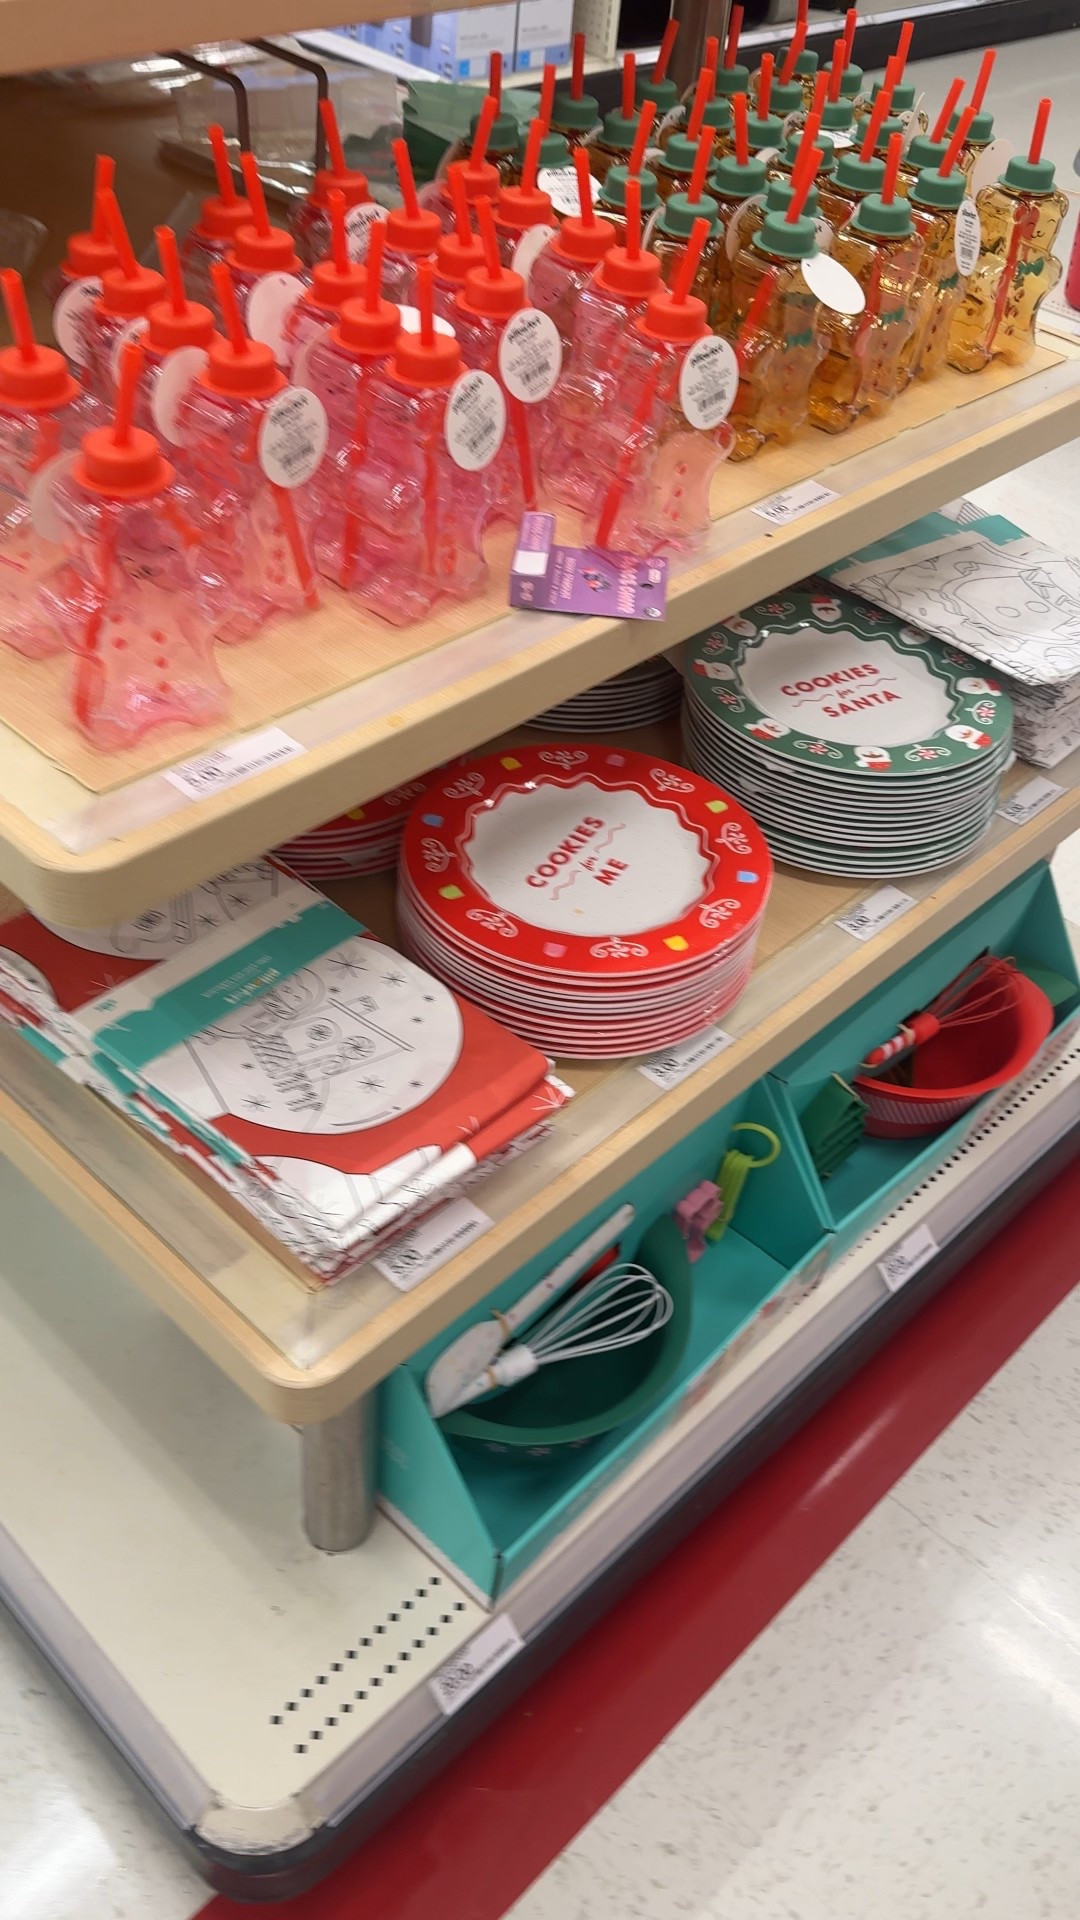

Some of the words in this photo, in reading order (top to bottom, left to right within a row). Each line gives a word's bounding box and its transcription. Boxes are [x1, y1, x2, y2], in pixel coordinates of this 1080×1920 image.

[781, 664, 880, 697] COOKIES
[836, 688, 855, 700] for
[821, 690, 902, 718] SANTA
[525, 816, 605, 888] COOKIES
[592, 858, 630, 888] ME
